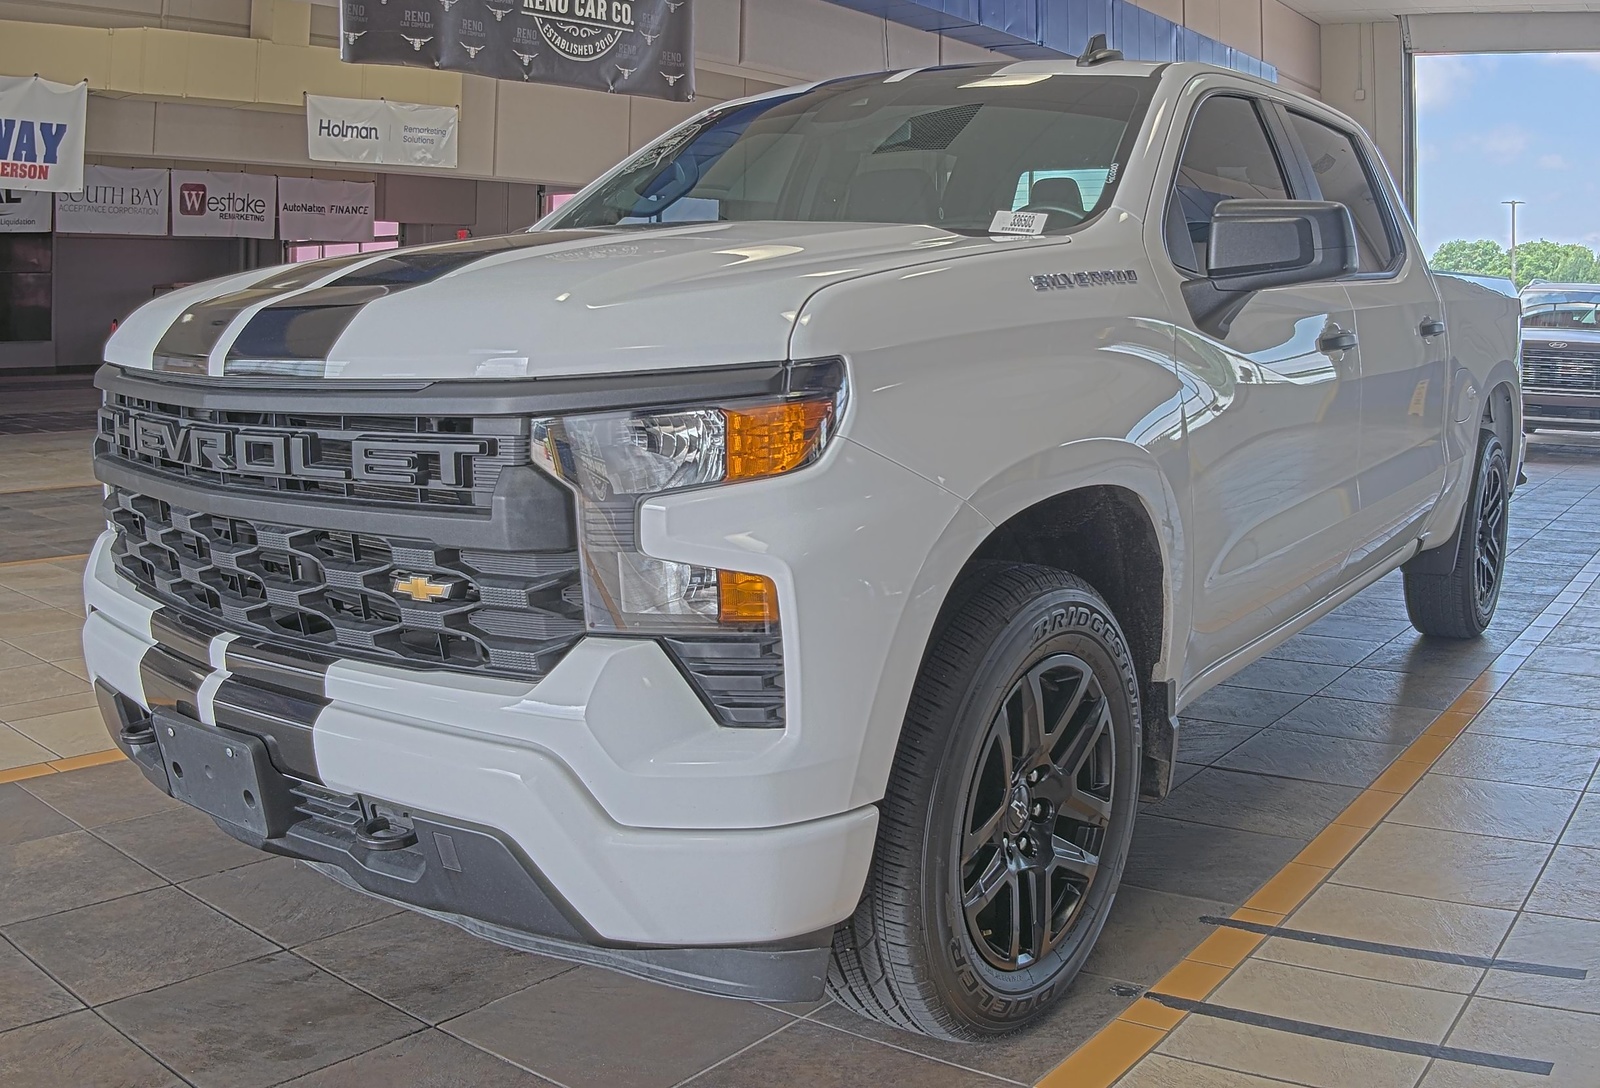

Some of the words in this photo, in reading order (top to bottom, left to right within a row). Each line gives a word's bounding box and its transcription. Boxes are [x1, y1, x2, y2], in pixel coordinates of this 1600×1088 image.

[404, 10, 431, 22] RENO
[574, 0, 607, 20] CAR
[612, 2, 635, 26] CO.
[462, 19, 483, 32] RENO
[516, 27, 537, 40] RENO
[543, 23, 594, 55] ESTABLISHED
[595, 33, 614, 52] 2010
[618, 43, 637, 55] RENO
[662, 51, 682, 63] RENO
[318, 119, 379, 140] Holman
[403, 125, 447, 138] Remarketing
[402, 135, 435, 145] Solutions
[59, 185, 124, 205] SOUTH
[131, 188, 163, 206] BAY
[183, 190, 266, 214] Westlake
[59, 204, 107, 213] ACCEPTANCE
[107, 206, 159, 216] CORPORATION
[282, 203, 326, 213] AutoNation
[329, 205, 369, 215] FINANCE
[0, 218, 36, 226] Liquidation
[219, 213, 265, 222] REMARKETING
[1029, 269, 1138, 291] SILVERADO
[98, 404, 500, 487] CHEVROLET
